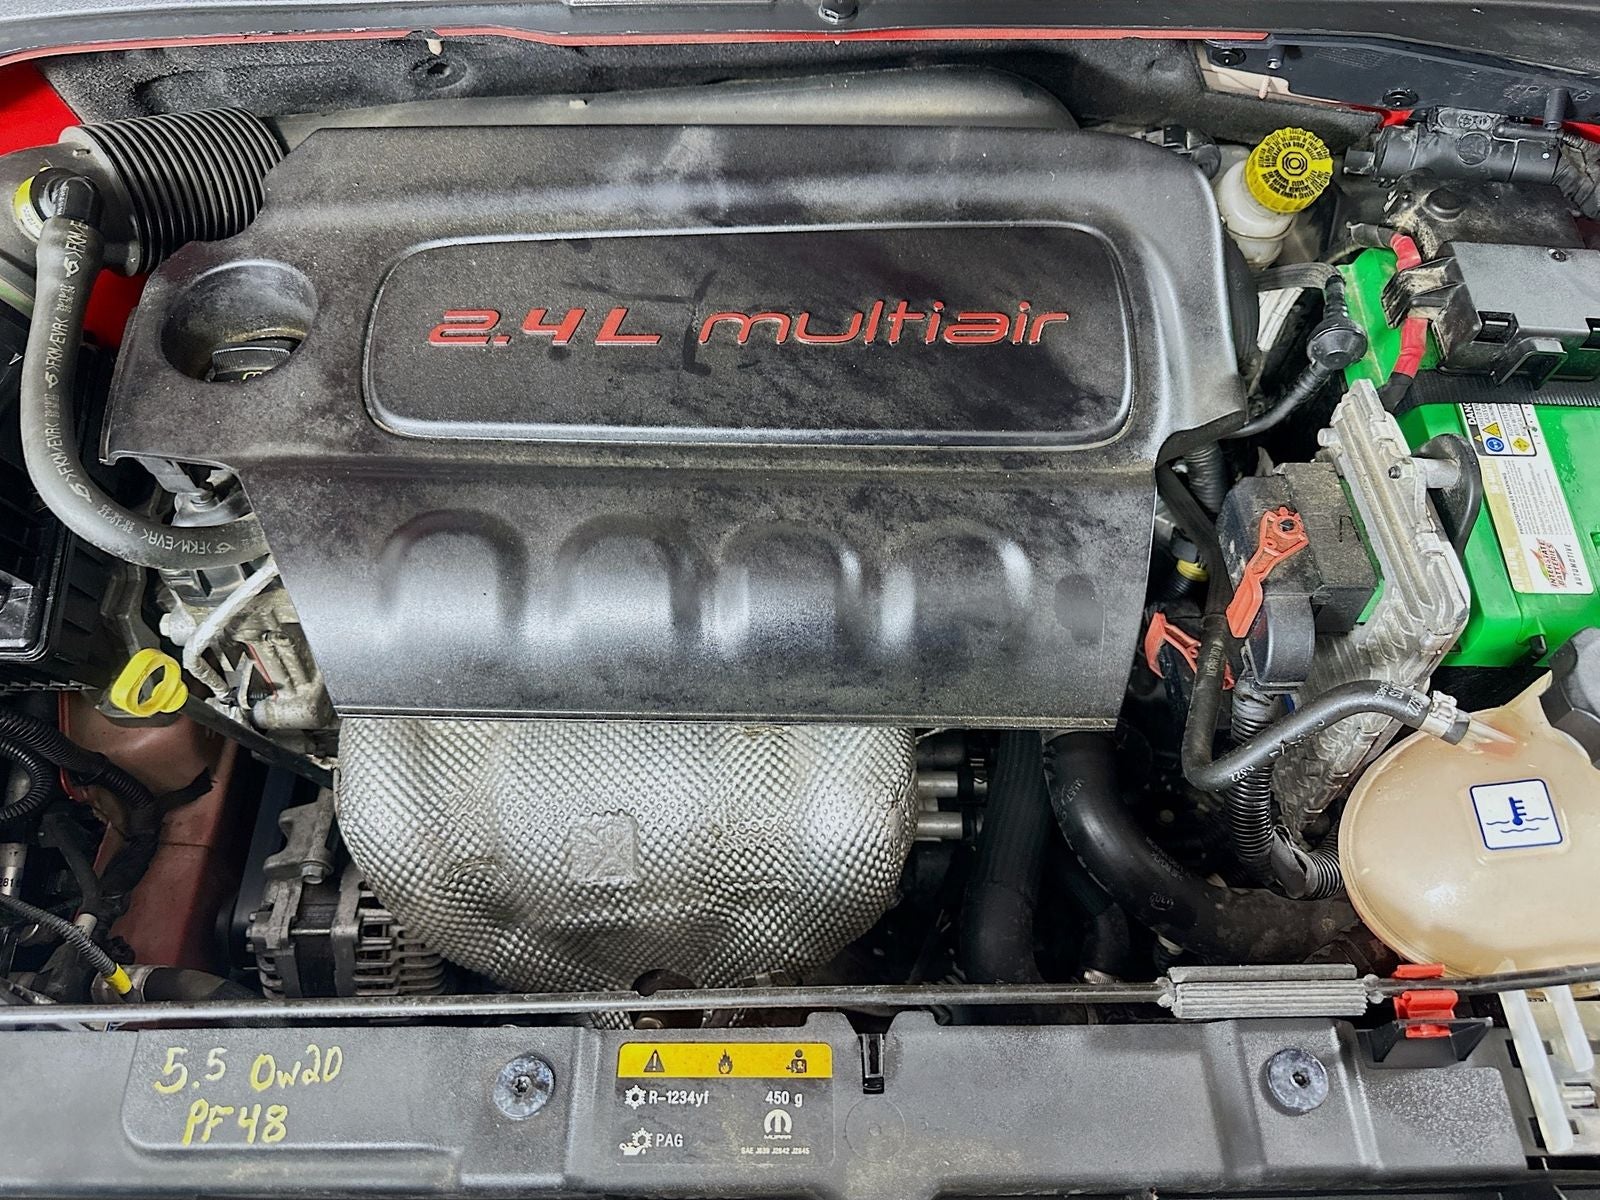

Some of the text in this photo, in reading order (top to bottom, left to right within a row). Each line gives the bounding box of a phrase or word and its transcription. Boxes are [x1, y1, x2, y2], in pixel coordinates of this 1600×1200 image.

[699, 300, 1070, 346] multiair
[1540, 540, 1557, 587] INTERSTATE
[1564, 543, 1583, 586] AUTOMOTIVE
[154, 1047, 228, 1094] 5.5
[649, 1090, 803, 1108] R-1234yf 450 g
[656, 1134, 684, 1147] PAG
